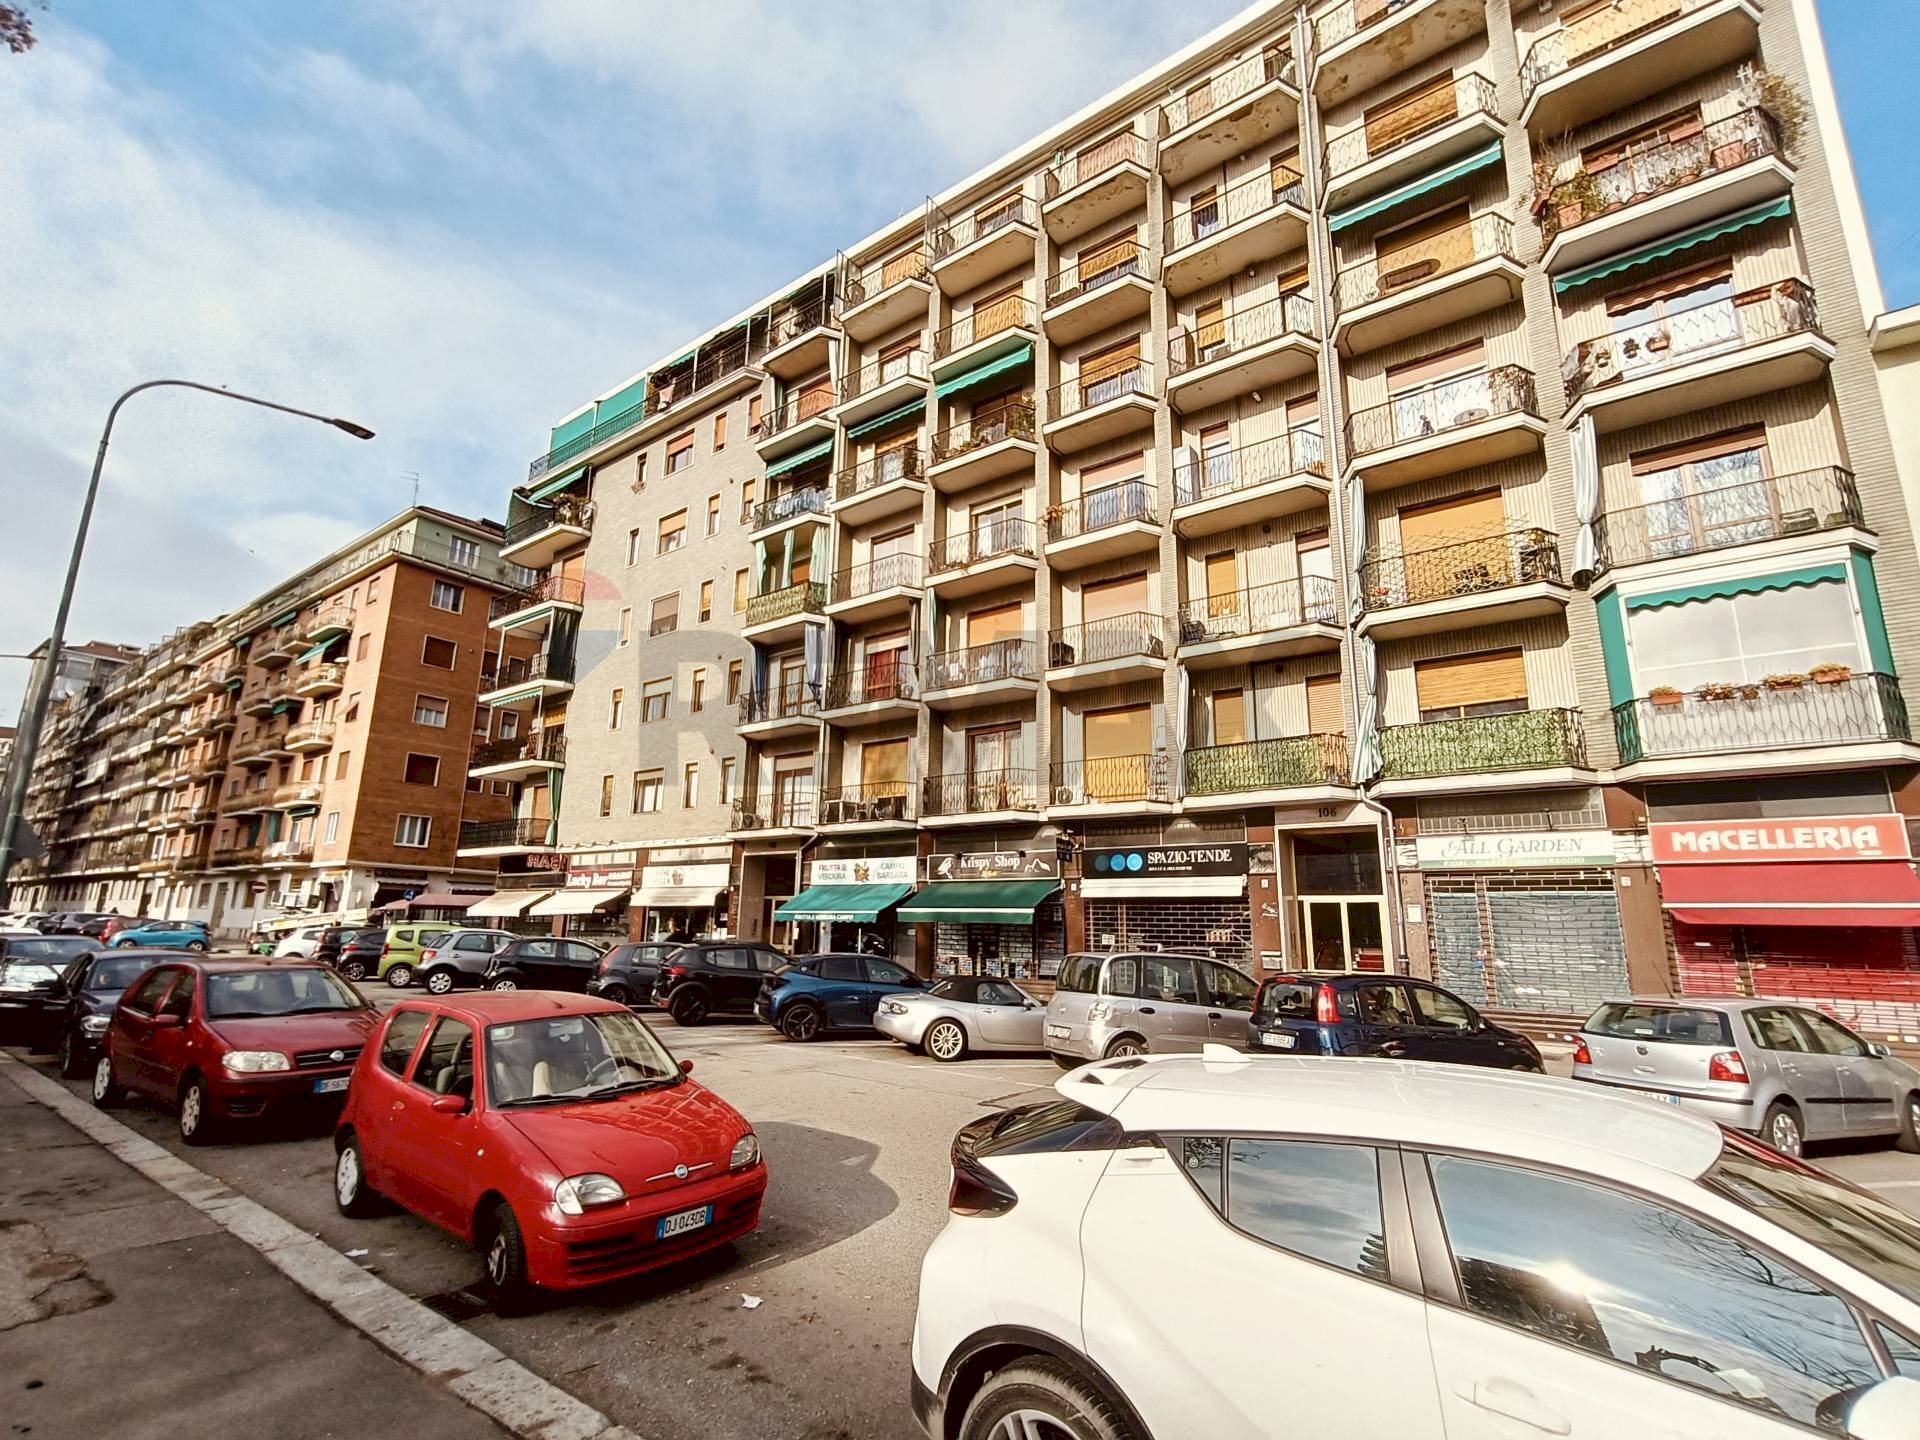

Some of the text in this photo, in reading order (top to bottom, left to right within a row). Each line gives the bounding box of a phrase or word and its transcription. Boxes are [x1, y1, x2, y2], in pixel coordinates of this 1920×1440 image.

[1318, 807, 1337, 818] 106
[1671, 825, 1881, 853] MACELLERIA
[1497, 837, 1584, 858] GARDEN
[960, 855, 1021, 870] Krispy Shop
[1147, 849, 1232, 865] SPAZIO-TENDE
[818, 864, 841, 872] FRUTTA
[880, 861, 904, 871] CAMPO
[567, 872, 592, 889] Lucky
[817, 872, 846, 881] VERDURA
